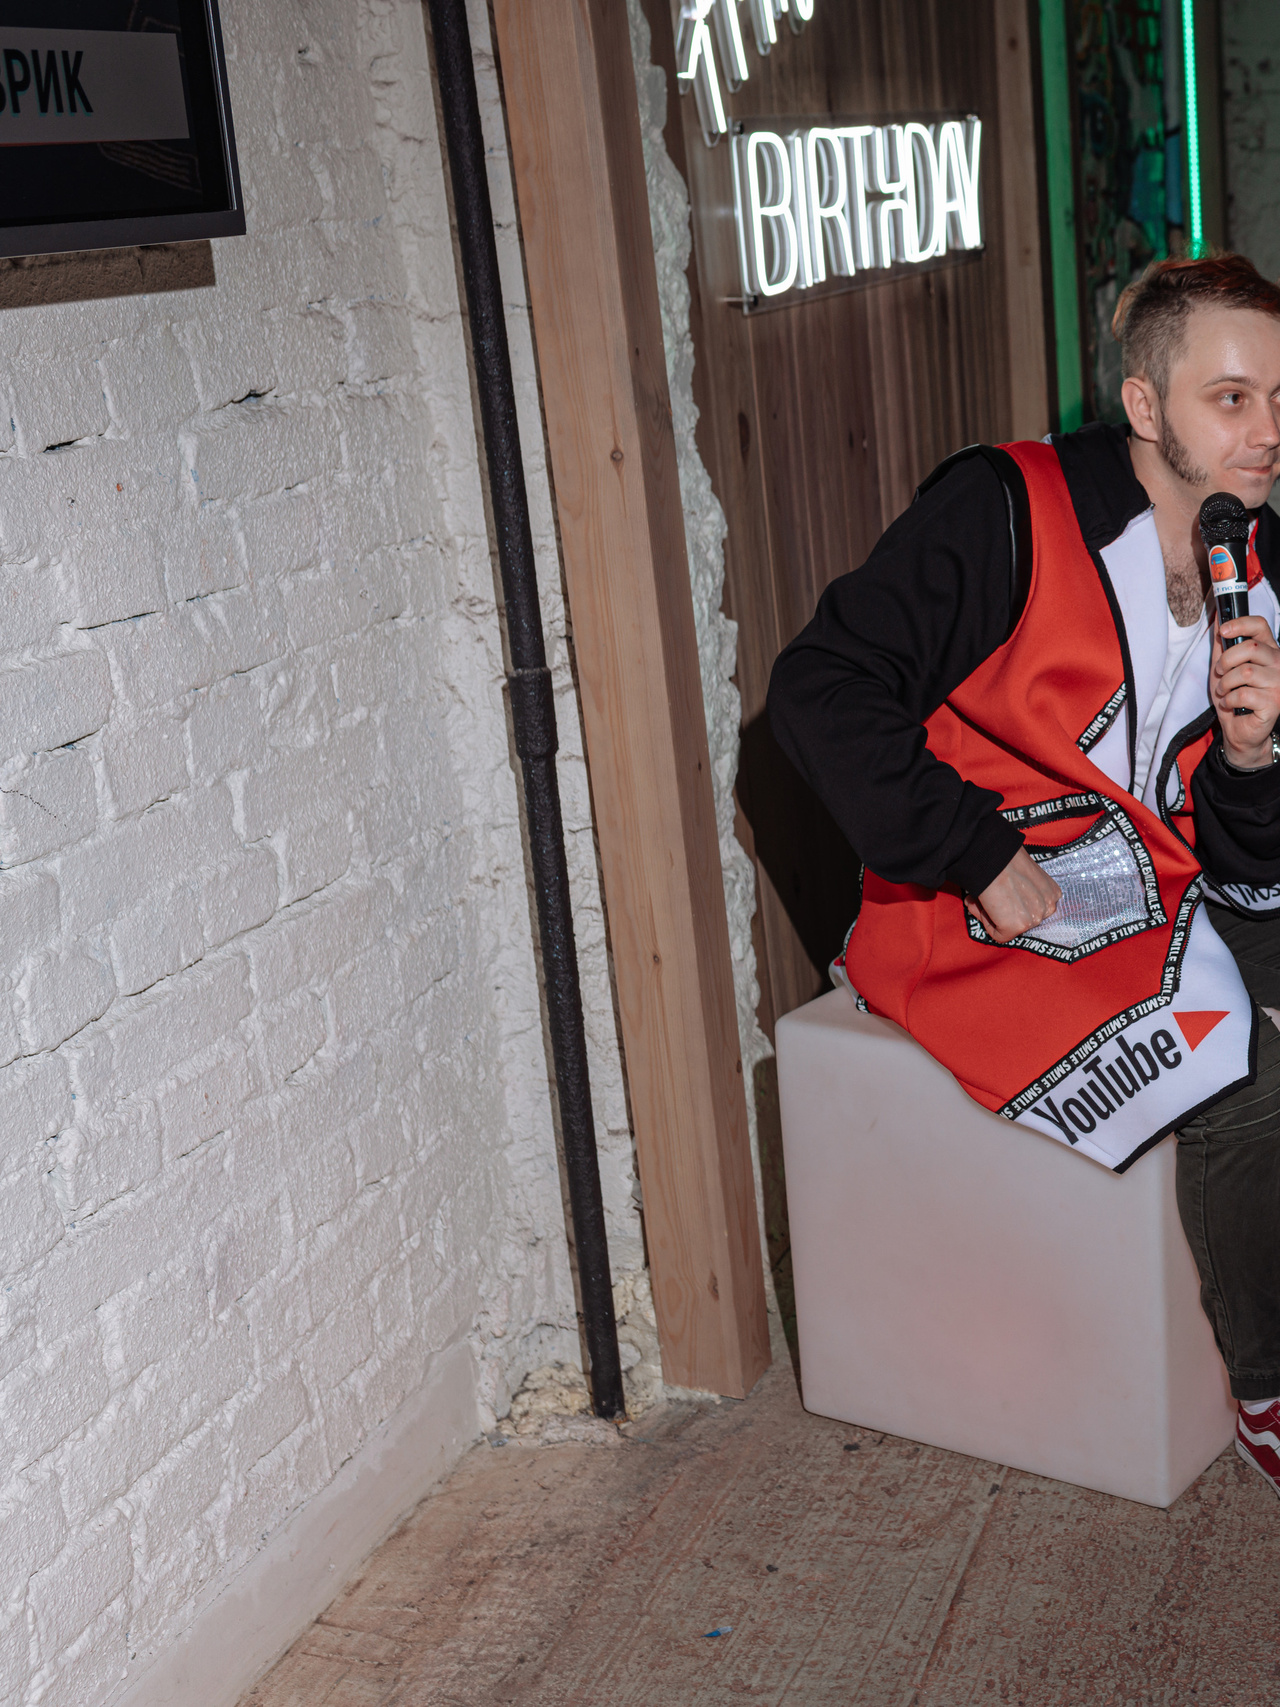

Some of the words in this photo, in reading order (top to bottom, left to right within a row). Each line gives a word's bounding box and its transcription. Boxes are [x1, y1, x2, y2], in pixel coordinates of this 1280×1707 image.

[0, 49, 94, 114] РИК
[735, 120, 982, 297] BIRTHDAY
[1080, 714, 1108, 746] SMILE
[1029, 801, 1063, 818] SMILE
[1065, 795, 1088, 809] SMILE
[1113, 811, 1138, 840] SMILE
[1175, 901, 1192, 927] SMILE
[1111, 922, 1146, 939] SMILE
[1046, 945, 1073, 961] MILE
[1073, 937, 1108, 958] SMILE
[1167, 931, 1185, 962] SMILE
[1161, 966, 1175, 1004] SMILE
[1129, 995, 1169, 1020] SMILE
[1096, 1014, 1128, 1043] SMILE
[1069, 1037, 1098, 1065] SMILE
[1031, 1028, 1183, 1145] YouTube
[1041, 1060, 1072, 1088] SMILE
[1013, 1083, 1043, 1112] SMILE
